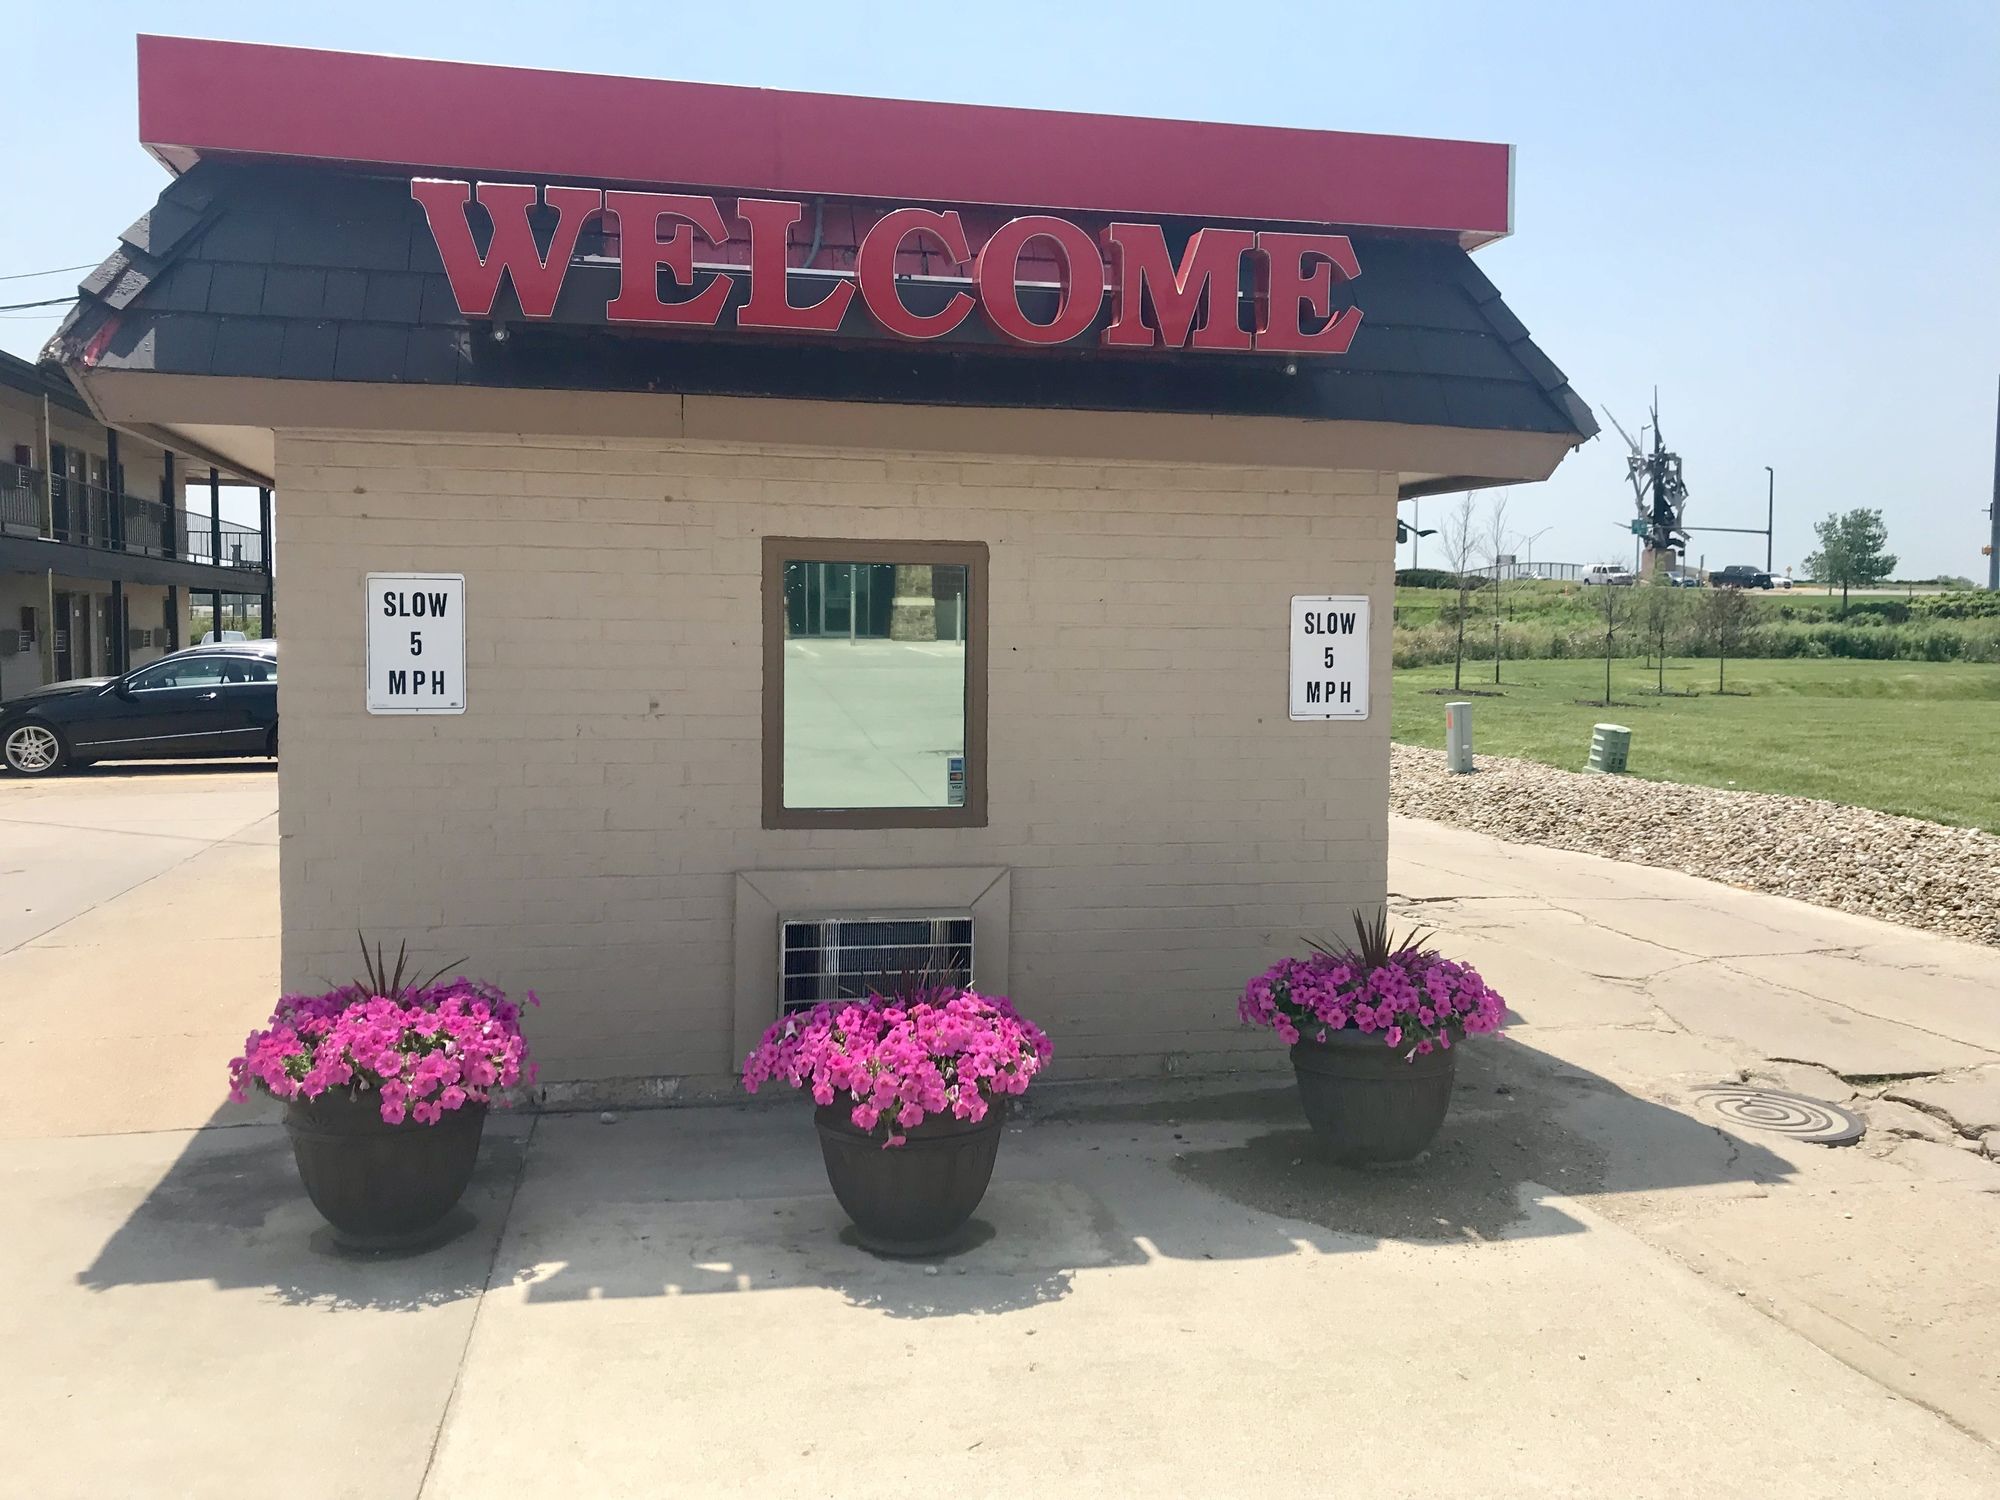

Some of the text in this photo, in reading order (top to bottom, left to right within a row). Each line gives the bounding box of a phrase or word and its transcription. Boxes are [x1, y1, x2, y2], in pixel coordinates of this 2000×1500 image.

[410, 176, 1364, 355] WELCOME
[384, 591, 448, 617] SLOW
[1304, 612, 1356, 635] SLOW
[410, 631, 422, 656] 5
[1324, 647, 1334, 669] 5
[389, 670, 445, 695] MPH
[1306, 681, 1351, 703] MPH
